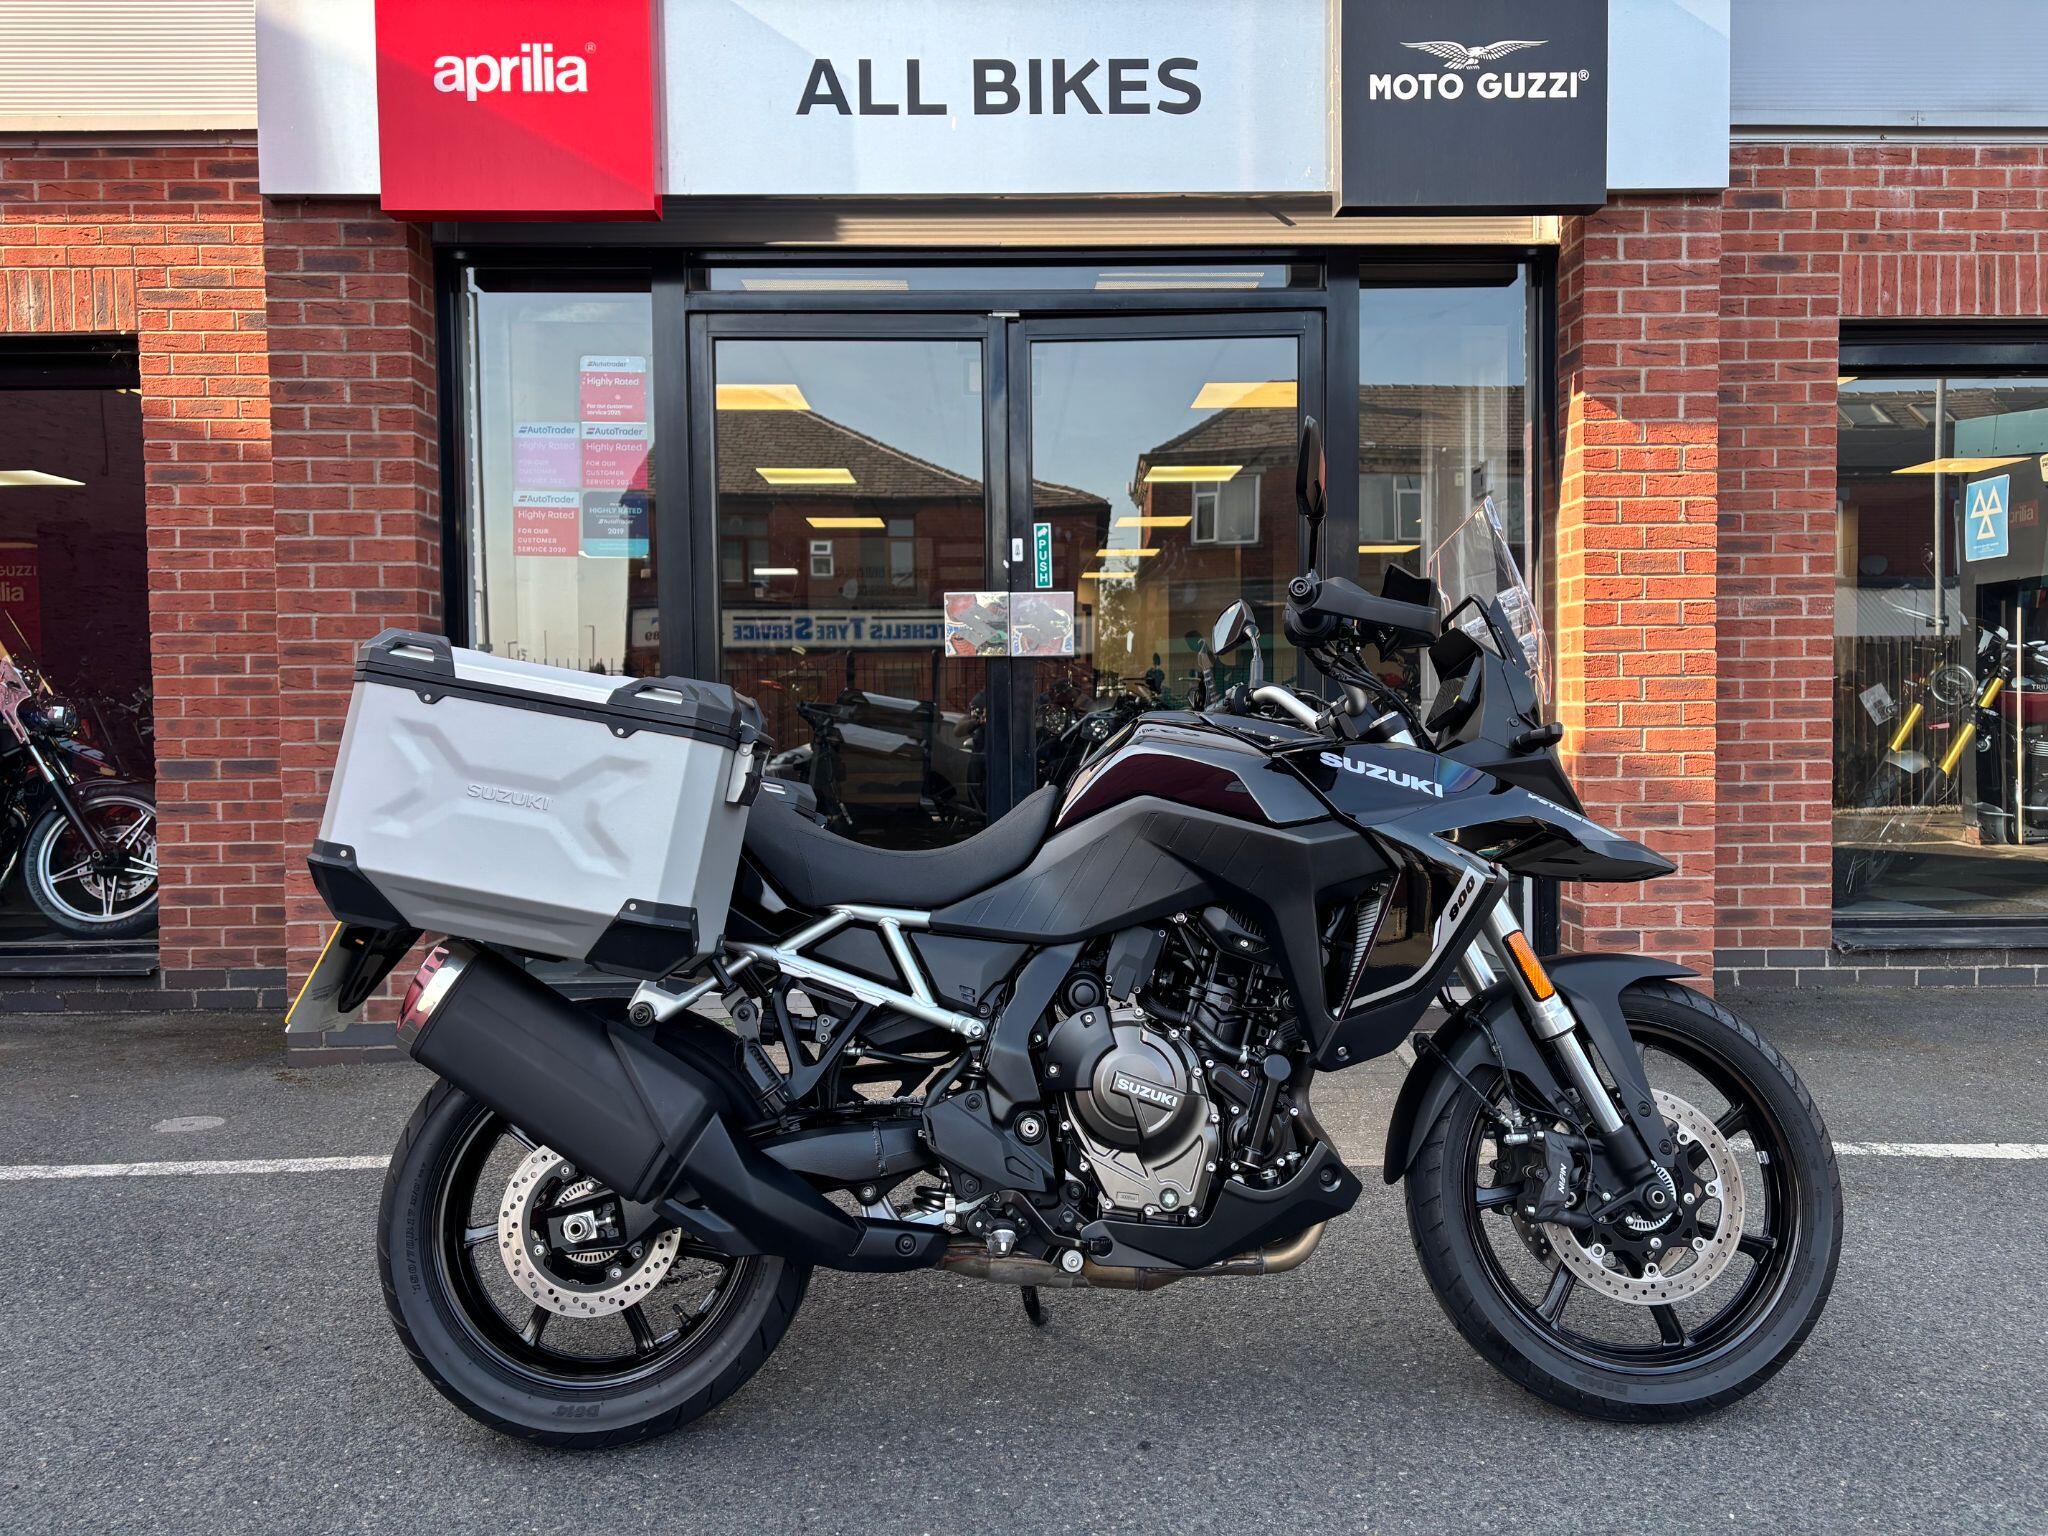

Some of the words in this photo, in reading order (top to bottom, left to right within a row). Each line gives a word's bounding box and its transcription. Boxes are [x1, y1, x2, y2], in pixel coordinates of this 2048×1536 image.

[433, 43, 587, 102] aprilia
[796, 58, 947, 115] ALL
[973, 57, 1202, 115] BIKES
[1369, 72, 1464, 100] MOTO
[1477, 72, 1578, 99] GUZZI
[586, 377, 613, 386] Highly
[614, 377, 640, 386] Rated
[527, 425, 575, 434] AutoTrader
[595, 427, 643, 436] AutoTrader
[586, 442, 614, 453] Highly
[615, 442, 642, 451] Rated
[527, 495, 575, 504] AutoTrader
[518, 510, 546, 520] Highly
[547, 510, 575, 519] Rated
[2010, 504, 2034, 523] prilia
[607, 527, 624, 535] 2019
[1038, 539, 1049, 583] PUSH
[1319, 751, 1443, 798] SUZUKI
[466, 783, 550, 811] SUZUKI
[1448, 875, 1475, 922] 800
[1117, 1078, 1178, 1108] SUZUKI
